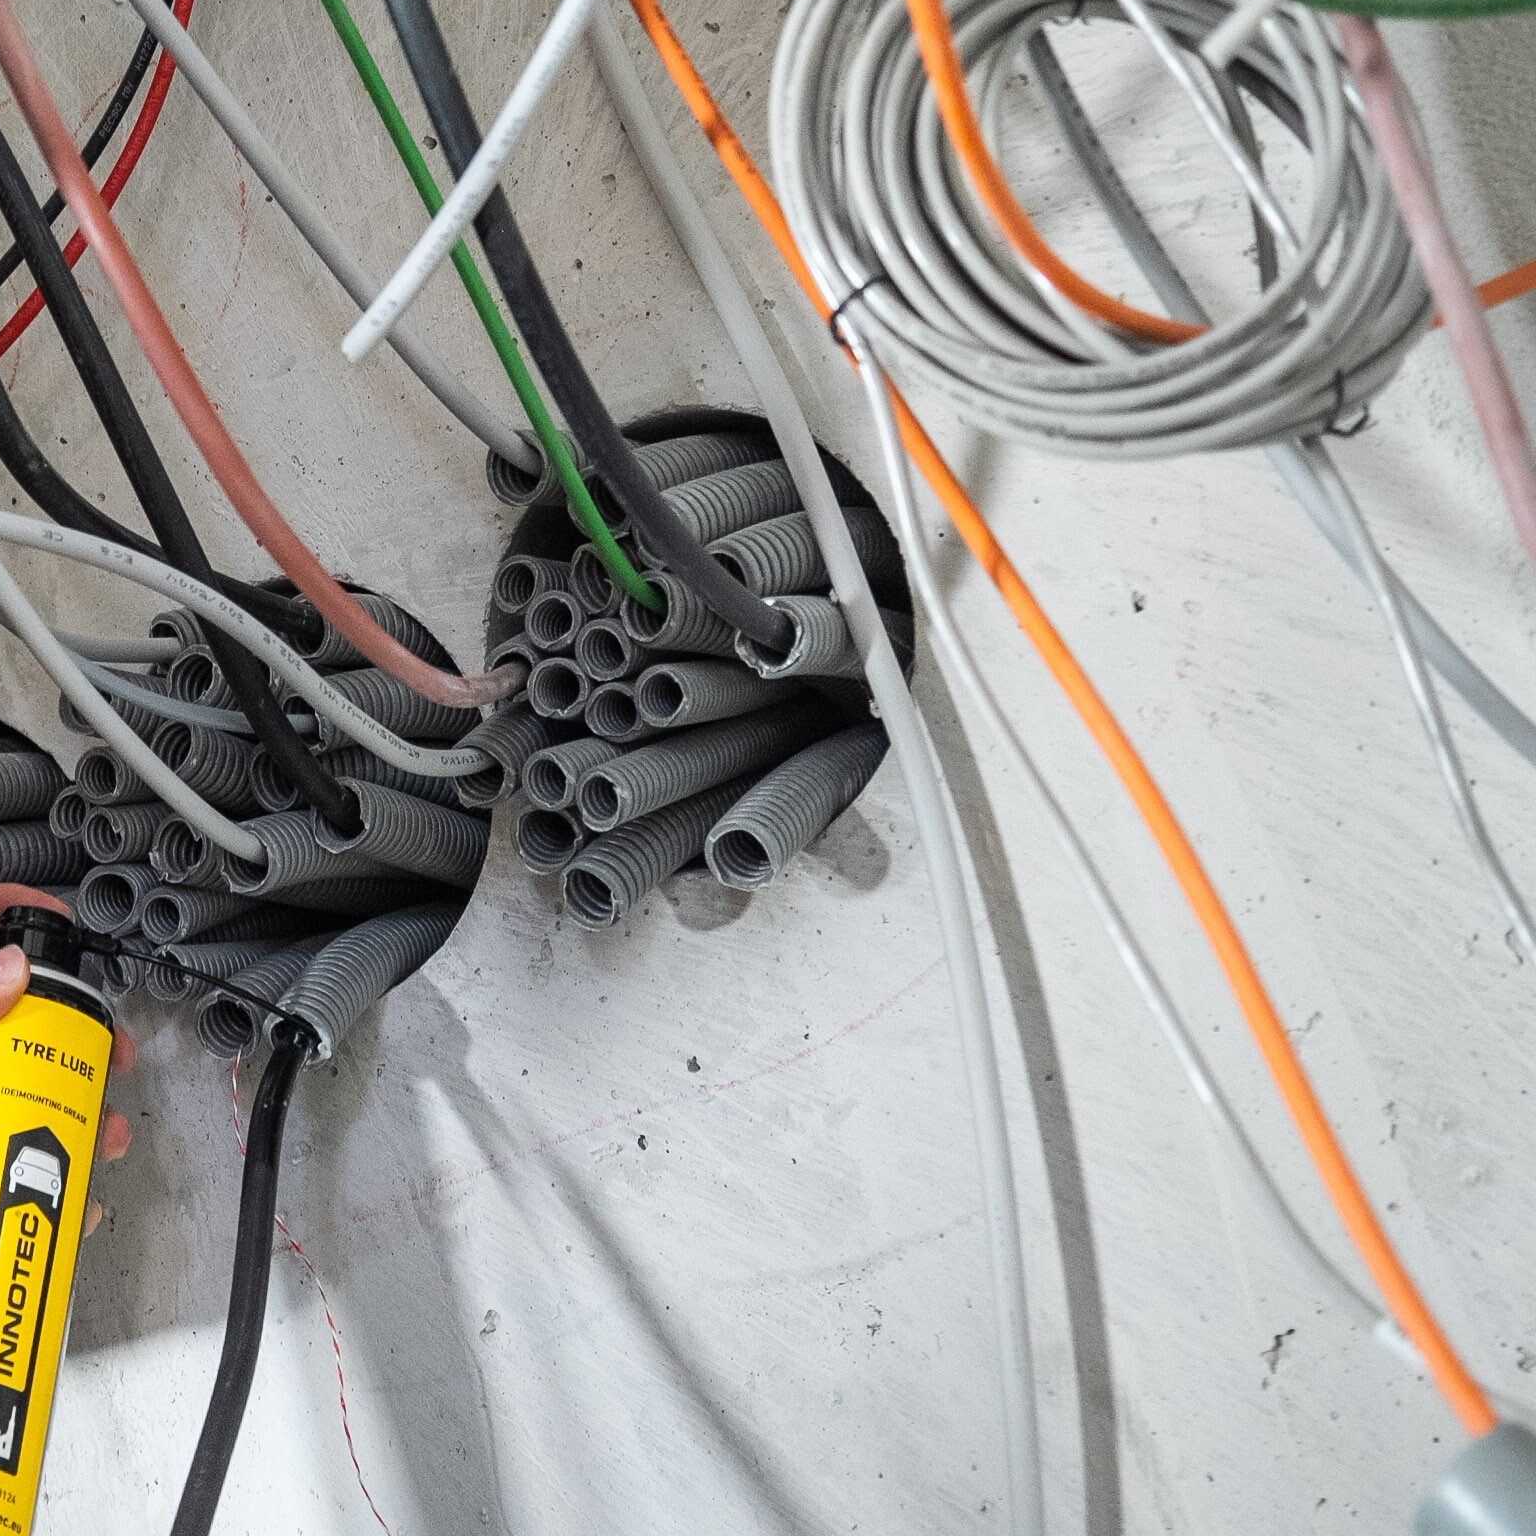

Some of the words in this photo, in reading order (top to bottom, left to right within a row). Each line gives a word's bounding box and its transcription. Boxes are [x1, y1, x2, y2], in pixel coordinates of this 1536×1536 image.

[11, 1037, 57, 1063] TYRE
[60, 1051, 96, 1083] LUBE
[0, 1086, 62, 1112] (DE)MOUNTING
[63, 1105, 88, 1126] GREASE
